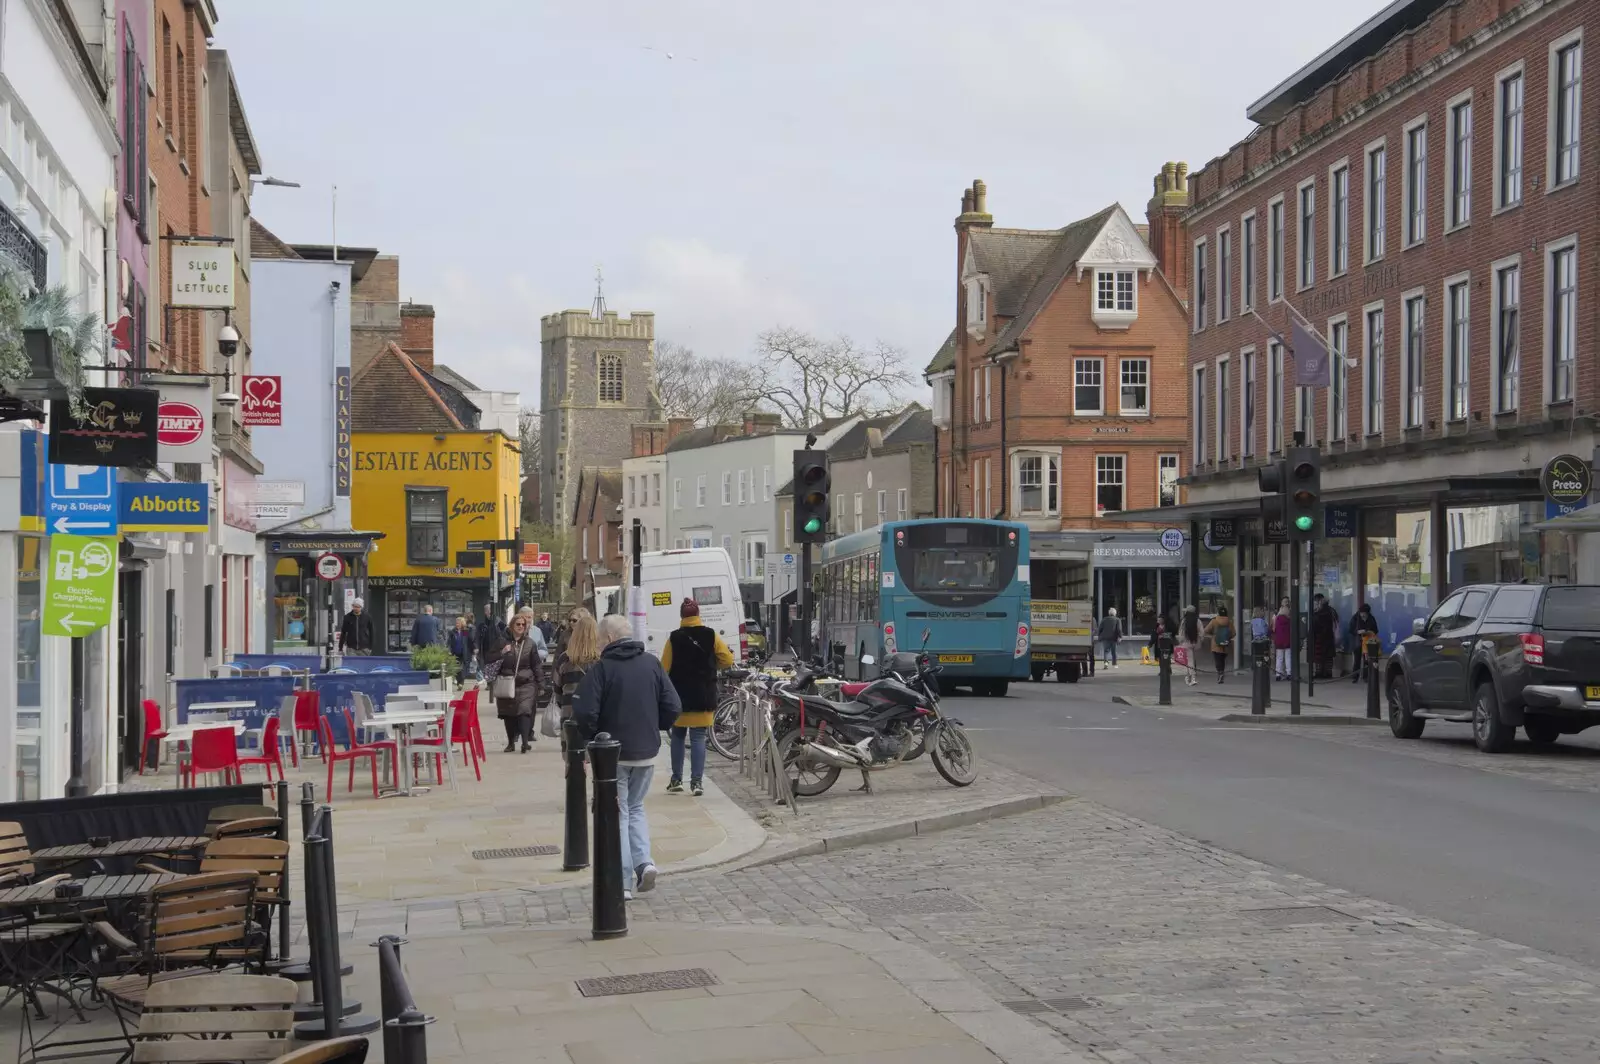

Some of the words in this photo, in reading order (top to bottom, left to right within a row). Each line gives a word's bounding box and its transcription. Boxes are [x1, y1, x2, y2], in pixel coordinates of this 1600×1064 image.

[188, 261, 218, 271] SLUG
[200, 273, 207, 281] &
[177, 284, 229, 293] LETTUCE
[337, 375, 350, 488] CLAYDONS
[355, 451, 419, 471] ESTATE
[424, 451, 493, 471] AGENTS
[1552, 480, 1582, 490] Preto
[51, 502, 68, 512] Pay
[70, 503, 77, 511] &
[80, 502, 112, 512] Display
[130, 496, 201, 512] Abbotts
[449, 498, 496, 520] Saxons
[1558, 505, 1575, 513] Toy
[1334, 519, 1348, 527] Toy
[1330, 528, 1351, 536] Shop
[1094, 548, 1111, 556] REE
[1112, 548, 1135, 556] WISE
[387, 578, 424, 586] AGENTS
[84, 595, 106, 603] Points
[228, 708, 282, 717] LETTUC
